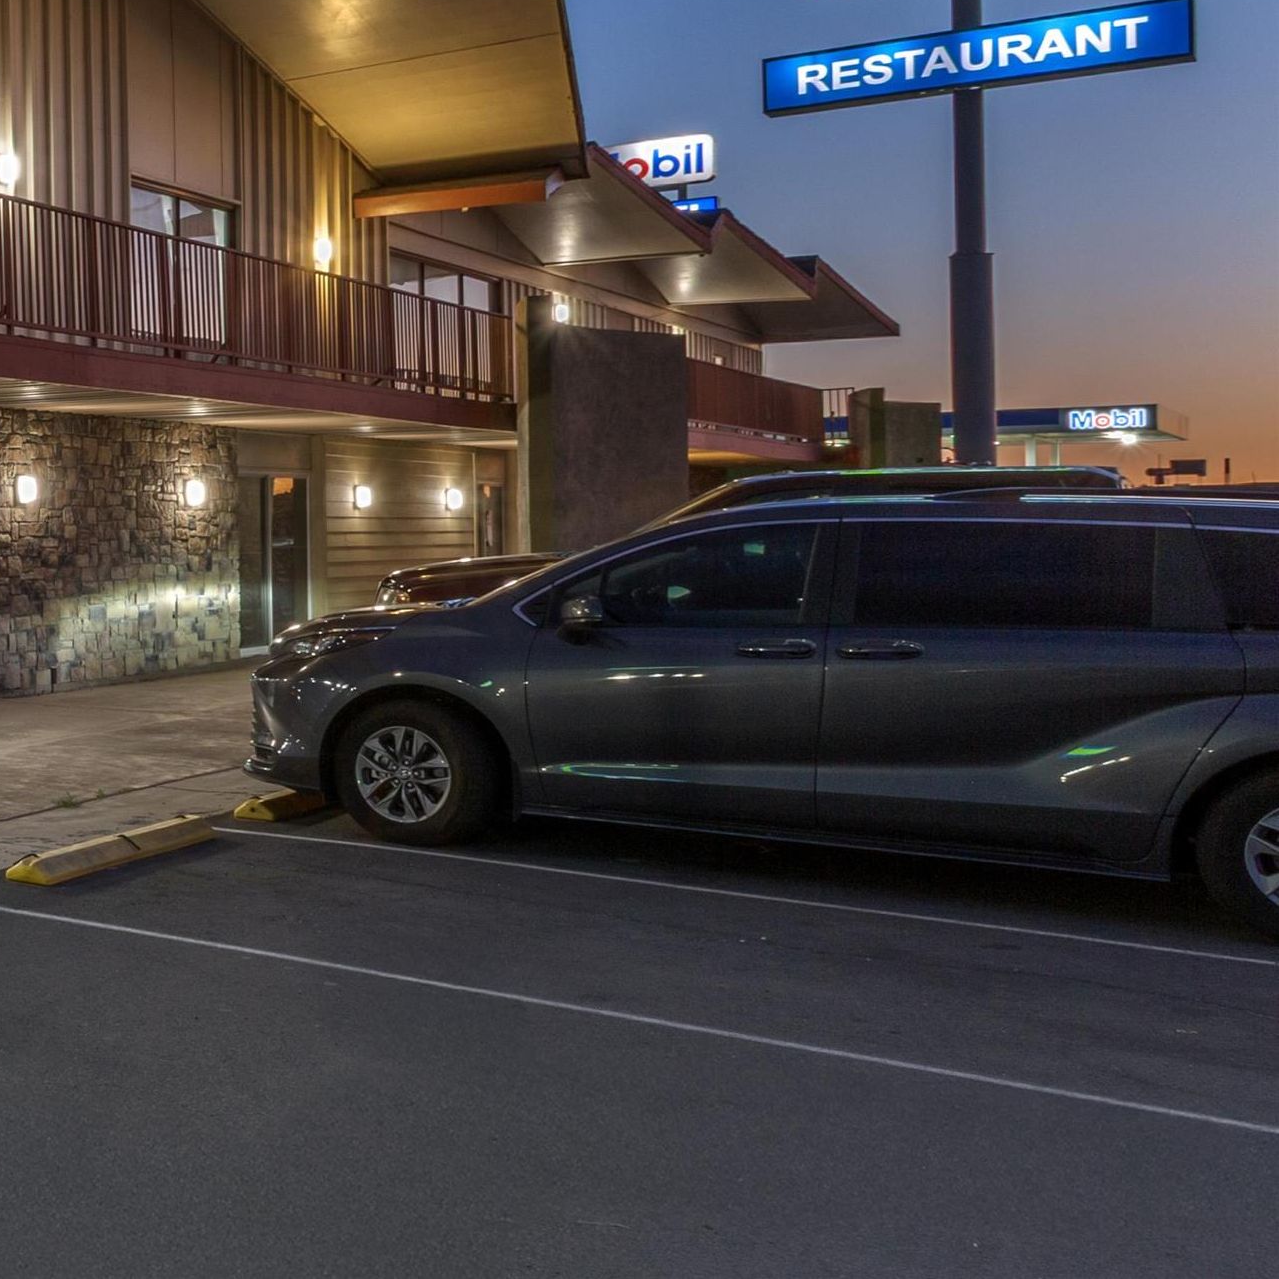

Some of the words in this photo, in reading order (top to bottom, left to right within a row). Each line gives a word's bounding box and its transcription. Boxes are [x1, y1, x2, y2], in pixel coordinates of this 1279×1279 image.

[797, 16, 1149, 95] RESTAURANT
[609, 142, 704, 180] obil
[1069, 408, 1147, 430] Mobil
